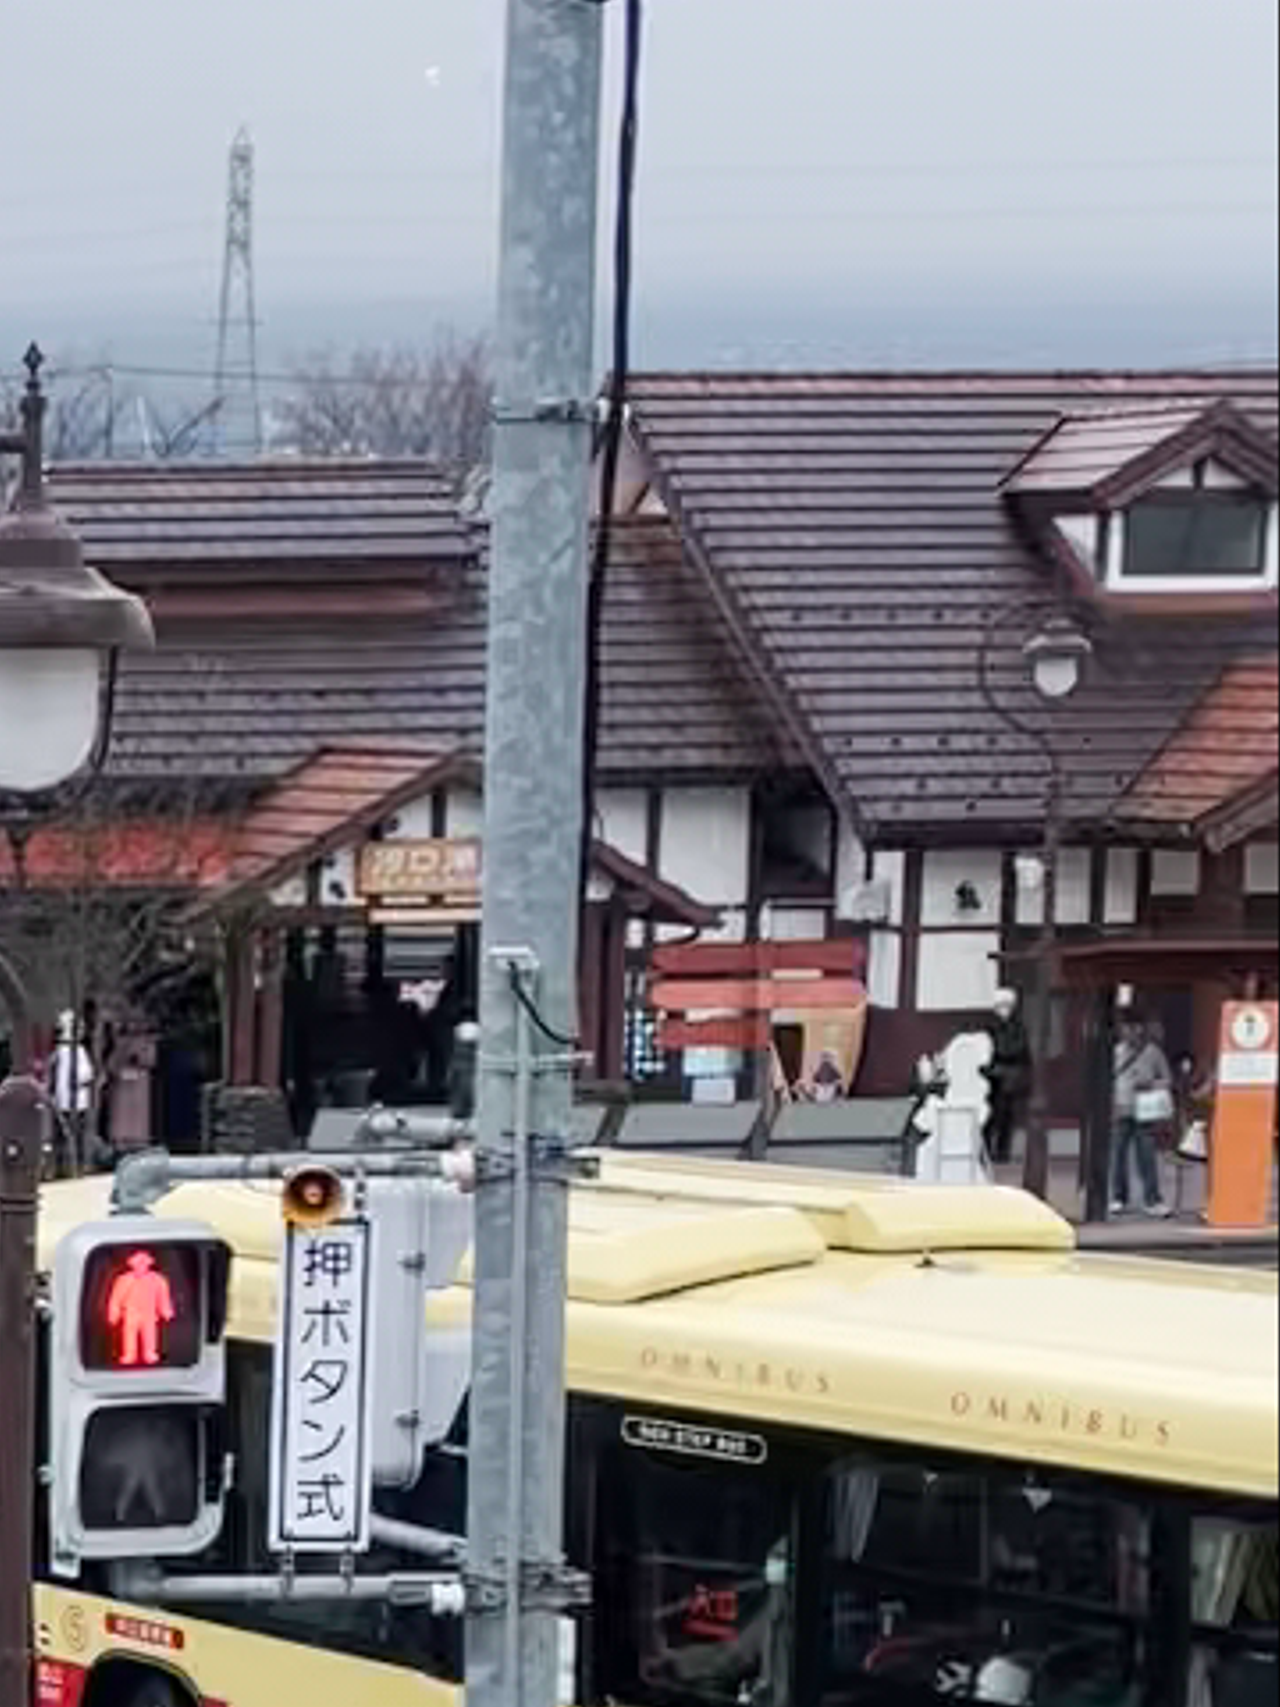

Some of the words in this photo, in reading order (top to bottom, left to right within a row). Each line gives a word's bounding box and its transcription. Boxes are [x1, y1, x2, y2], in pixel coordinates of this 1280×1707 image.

[297, 1239, 353, 1522] 押ボタン式
[640, 1347, 829, 1393] OMNIBUS
[950, 1391, 1170, 1447] OMNIBUS
